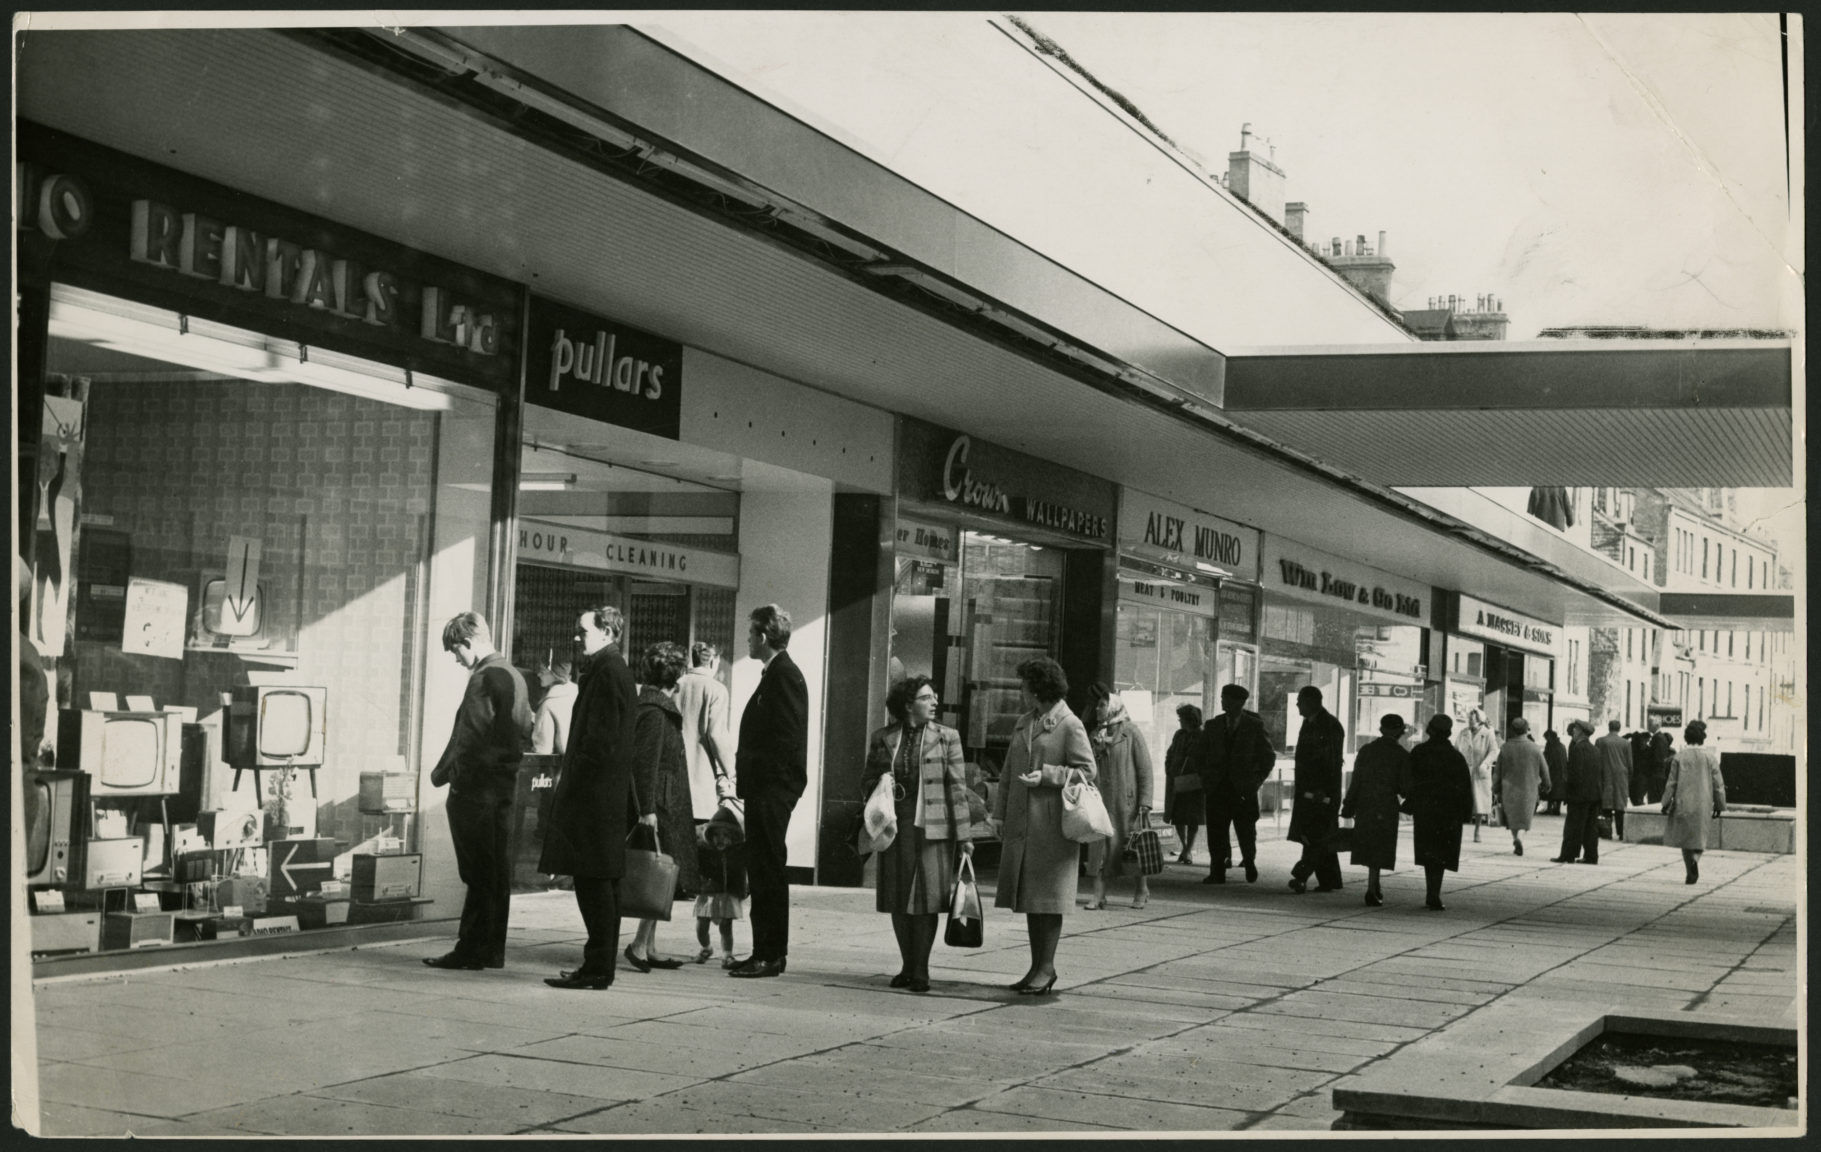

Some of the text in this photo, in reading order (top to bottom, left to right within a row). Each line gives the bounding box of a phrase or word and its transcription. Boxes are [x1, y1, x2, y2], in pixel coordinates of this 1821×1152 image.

[130, 199, 398, 327] RENTALS
[421, 286, 499, 355] Ltd
[549, 329, 663, 400] pullars
[943, 435, 1108, 538] Crown WALLPAPERS
[519, 530, 687, 572] HOUR CLEANING
[914, 527, 950, 551] Homes
[1144, 511, 1241, 567] ALEX MUNRO
[1134, 580, 1154, 597] MEAT
[1159, 586, 1165, 599] &
[1170, 588, 1201, 606] POULTRY
[1279, 558, 1421, 618] Wm Low & Co Ltd
[1476, 609, 1553, 645] A MASSEY & SONS
